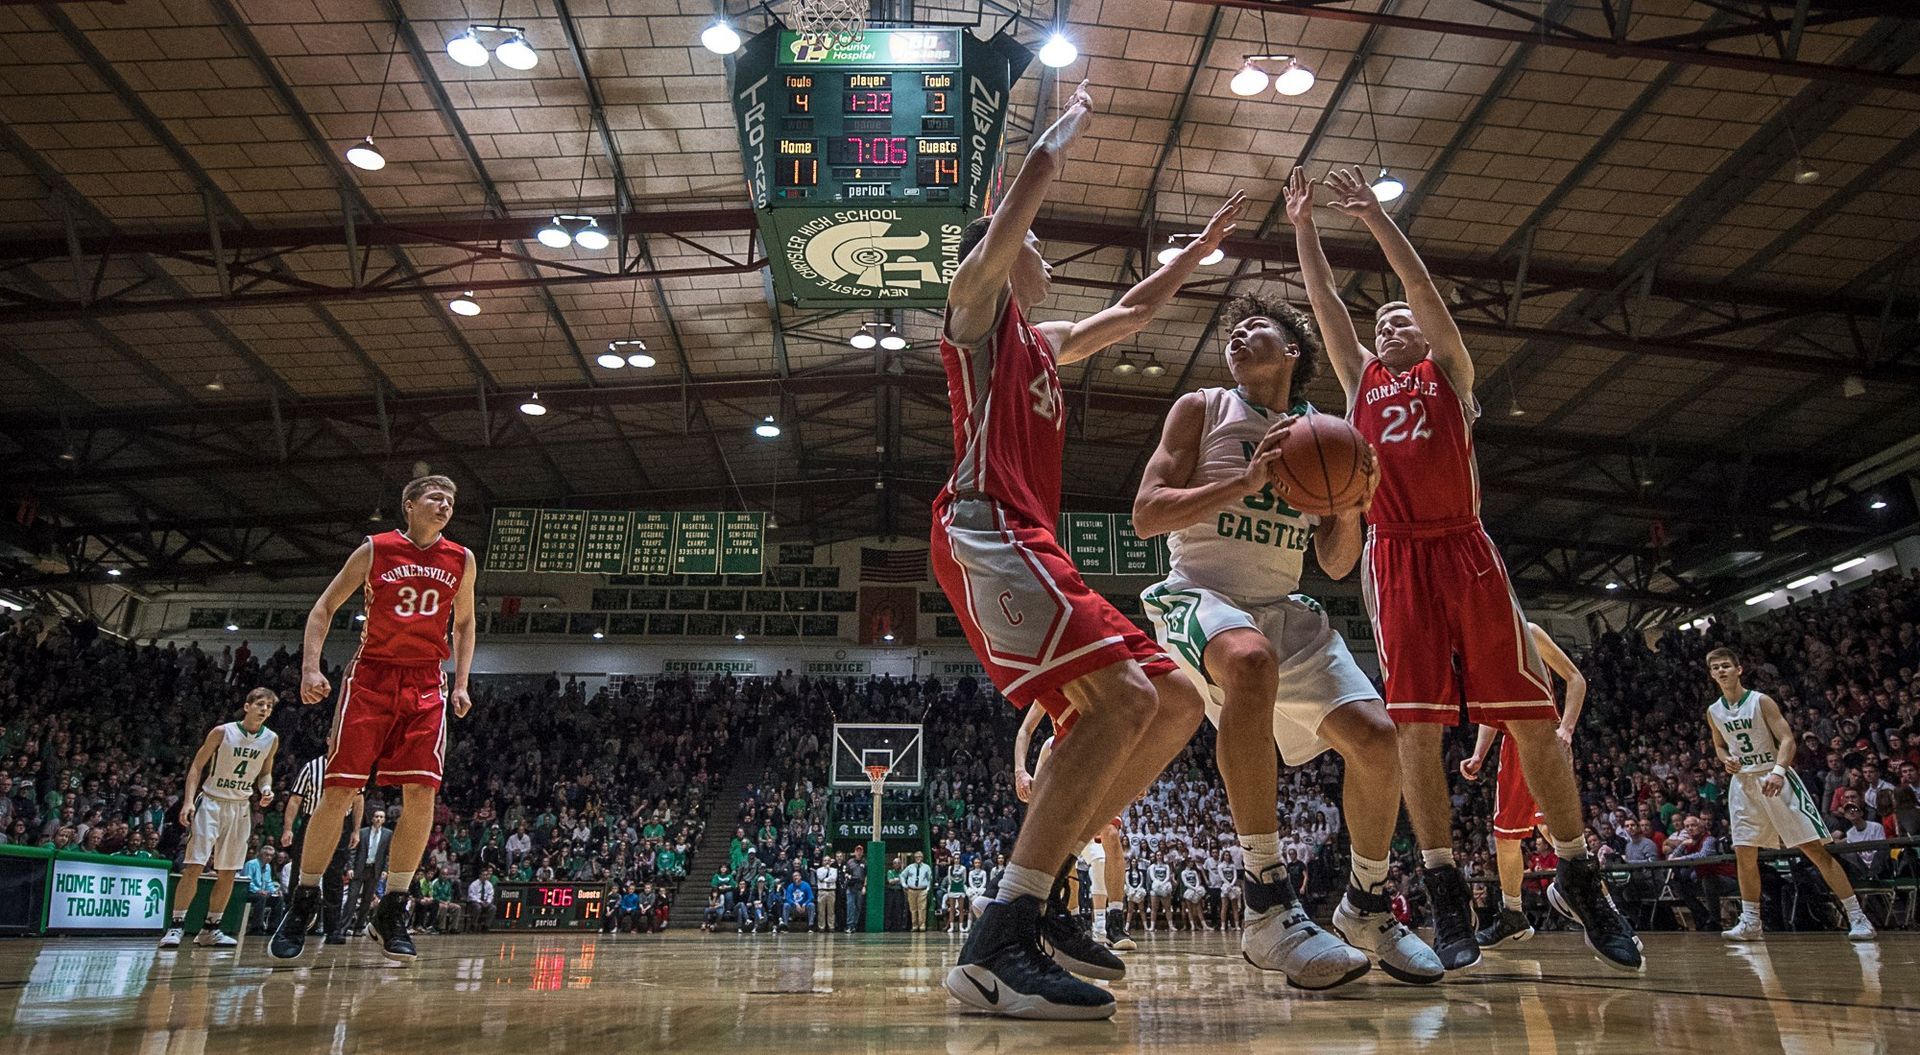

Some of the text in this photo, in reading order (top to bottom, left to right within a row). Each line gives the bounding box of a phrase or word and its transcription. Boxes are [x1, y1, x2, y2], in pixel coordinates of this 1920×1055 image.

[833, 43, 871, 52] County
[833, 51, 876, 61] Hospital
[786, 76, 812, 88] fouls
[850, 75, 886, 88] player
[925, 75, 951, 87] fouls
[796, 94, 809, 113] 4
[851, 93, 892, 113] 1-32
[934, 93, 947, 113] 3
[740, 75, 768, 209] TROJANS
[780, 140, 813, 155] Home
[918, 140, 958, 154] Guests
[847, 137, 908, 165] 7:06
[793, 159, 818, 186] 11
[855, 168, 862, 179] 2
[934, 159, 959, 186] 14
[970, 134, 986, 209] CASTLE
[848, 184, 886, 198] period
[786, 209, 909, 299] NEW CASTLE CHRYSLER HIGH SCHOOL
[941, 223, 962, 285] TROJANS
[1380, 398, 1433, 444] 22
[727, 523, 759, 531] BASKETBALL
[1076, 520, 1103, 528] WRESTLING
[685, 531, 710, 539] REGIONAL
[728, 531, 757, 539] SEMI-STATE
[1082, 533, 1097, 541] STATE
[1217, 514, 1305, 551] CASTLE
[1076, 546, 1105, 554] RUNNER-UP
[1082, 558, 1100, 567] 1995
[394, 586, 440, 618] 30
[998, 589, 1024, 628] C
[664, 662, 754, 672] SCHOLARSHIP
[808, 662, 864, 672] SERVICE
[1724, 718, 1753, 733] NEW
[1736, 732, 1754, 753] 3
[233, 747, 261, 760] NEW
[1739, 752, 1774, 766] ASTLE
[233, 760, 249, 779] 4
[216, 778, 254, 791] CASTLE
[852, 824, 905, 835] TROANS
[56, 873, 143, 897] HOME OF THE
[501, 889, 520, 899] Home
[539, 888, 573, 907] 7:06
[578, 889, 601, 899] Guests
[67, 898, 130, 919] TROJANS
[505, 902, 521, 919] 11
[585, 902, 601, 919] 14
[535, 919, 558, 928] period
